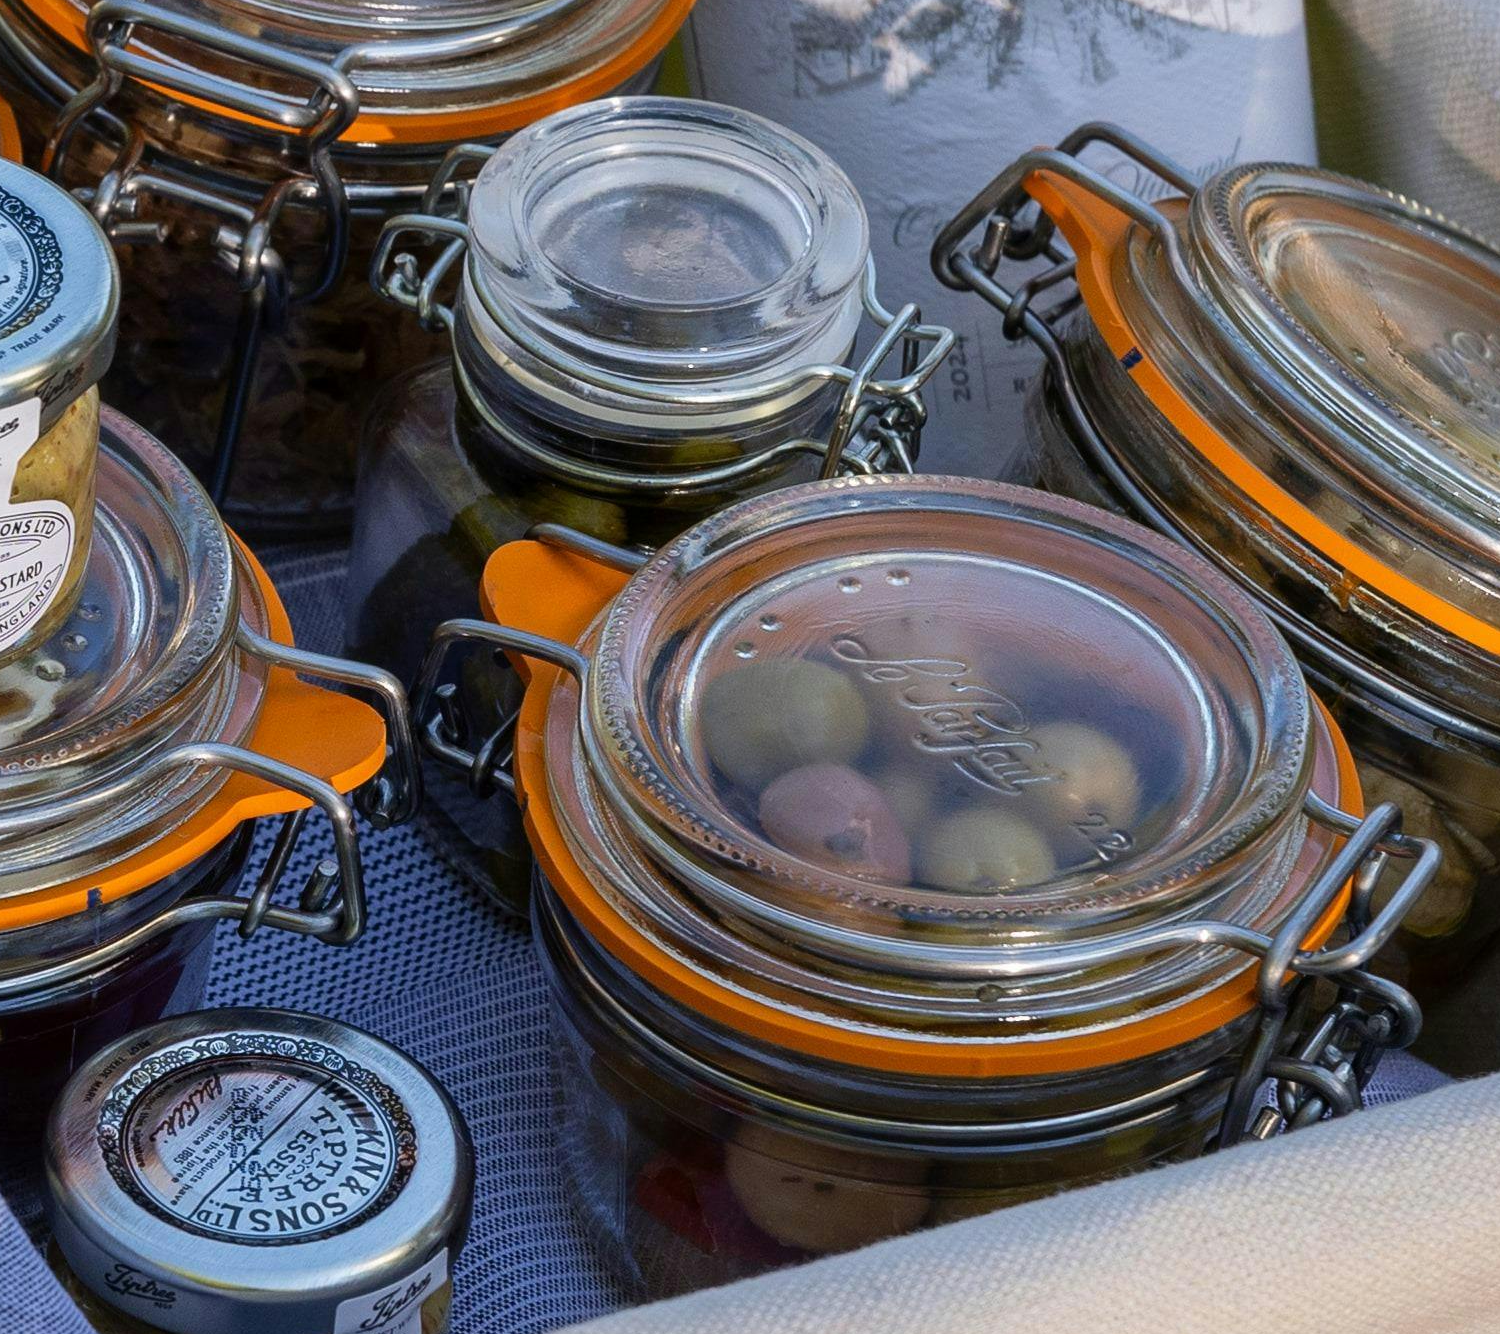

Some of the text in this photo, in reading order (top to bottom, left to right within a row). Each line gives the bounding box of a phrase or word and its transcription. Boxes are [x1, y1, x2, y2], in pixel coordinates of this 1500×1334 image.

[1, 294, 20, 313] this
[10, 332, 45, 353] TRADE
[41, 313, 67, 334] MARK
[34, 518, 57, 537] LTD
[169, 1182, 195, 1208] have
[249, 1192, 349, 1233] SONS
